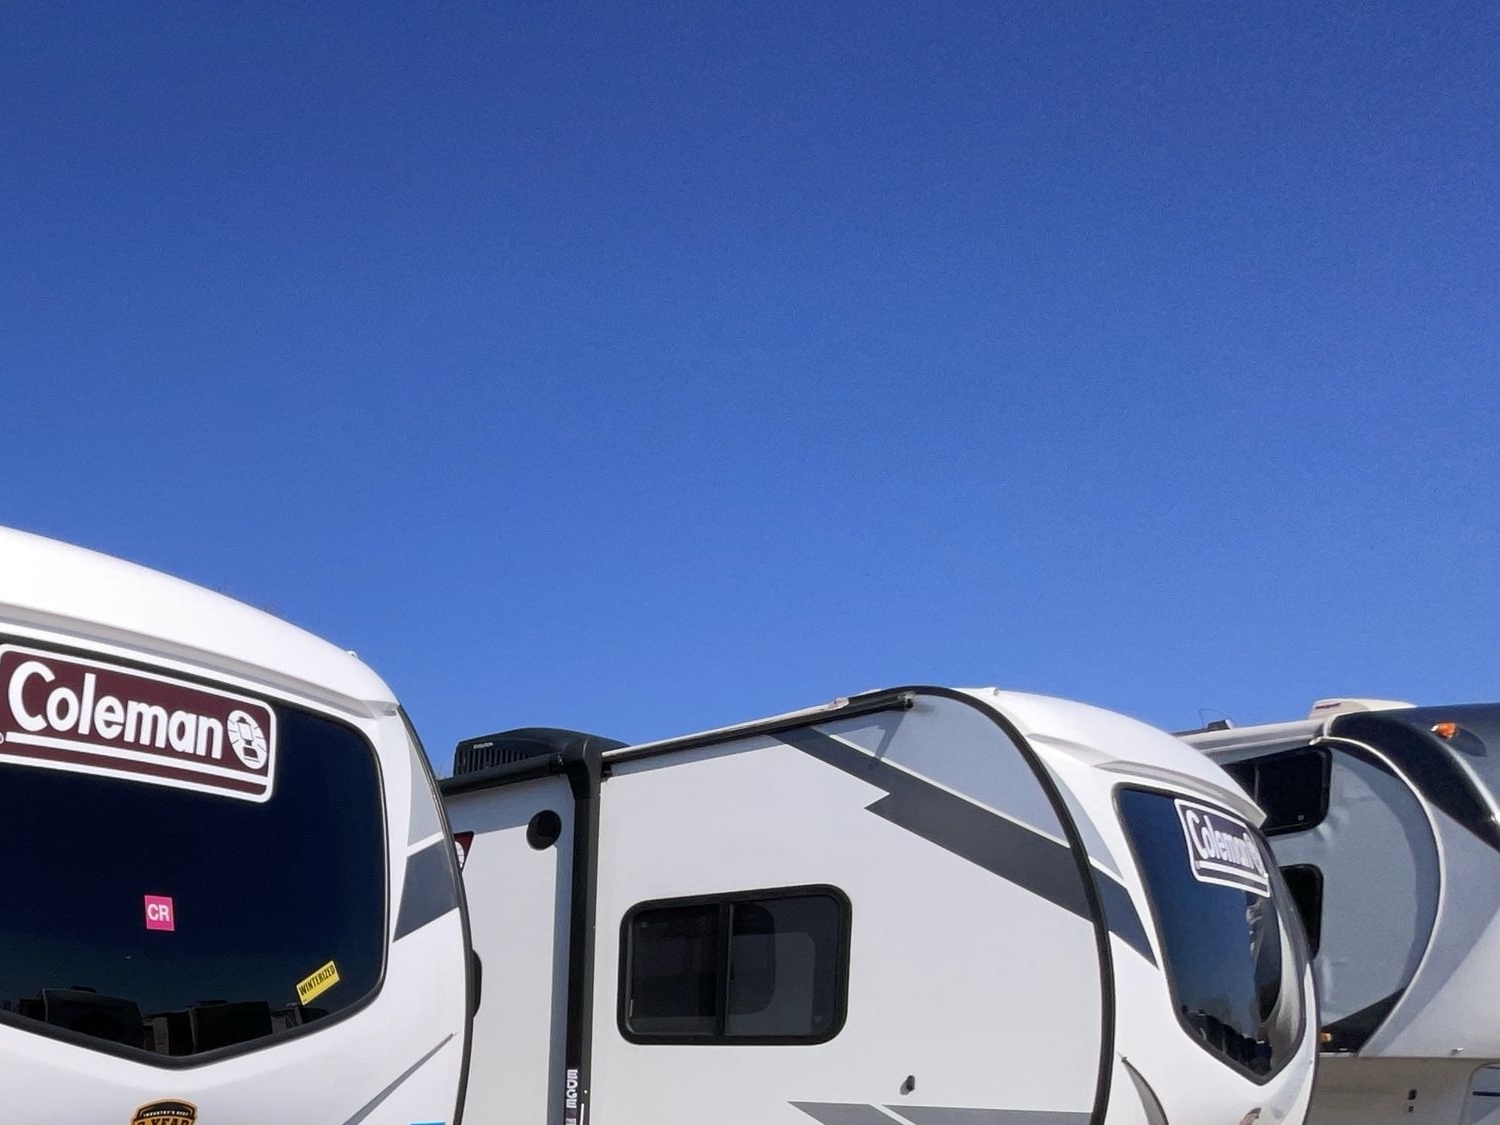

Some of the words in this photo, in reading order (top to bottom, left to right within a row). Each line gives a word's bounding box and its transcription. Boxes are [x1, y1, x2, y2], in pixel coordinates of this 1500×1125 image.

[8, 661, 223, 759] Coleman
[147, 903, 170, 922] CR
[299, 964, 336, 996] WINTERIZED
[566, 1069, 578, 1109] EDGE
